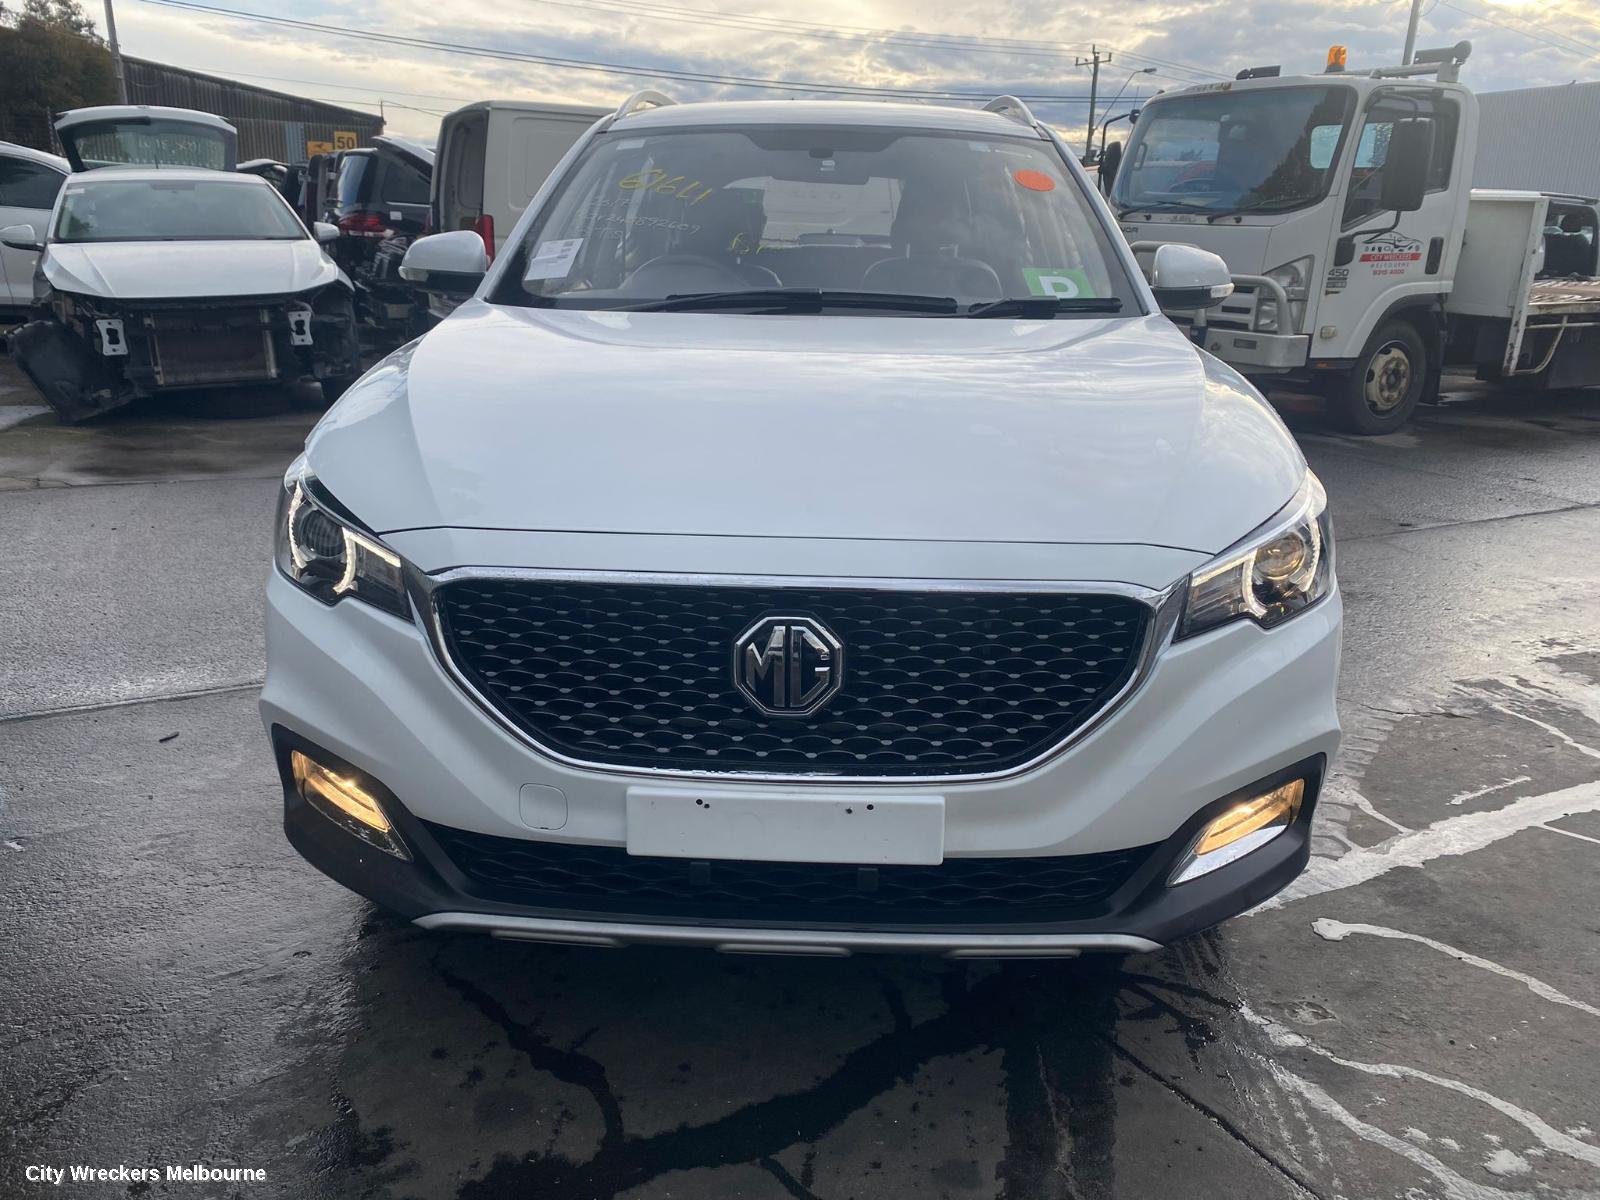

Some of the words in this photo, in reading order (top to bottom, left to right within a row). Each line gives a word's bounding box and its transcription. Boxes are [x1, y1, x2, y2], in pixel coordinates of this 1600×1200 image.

[337, 136, 355, 149] 50
[1328, 268, 1349, 277] 450
[746, 626, 830, 708] MG
